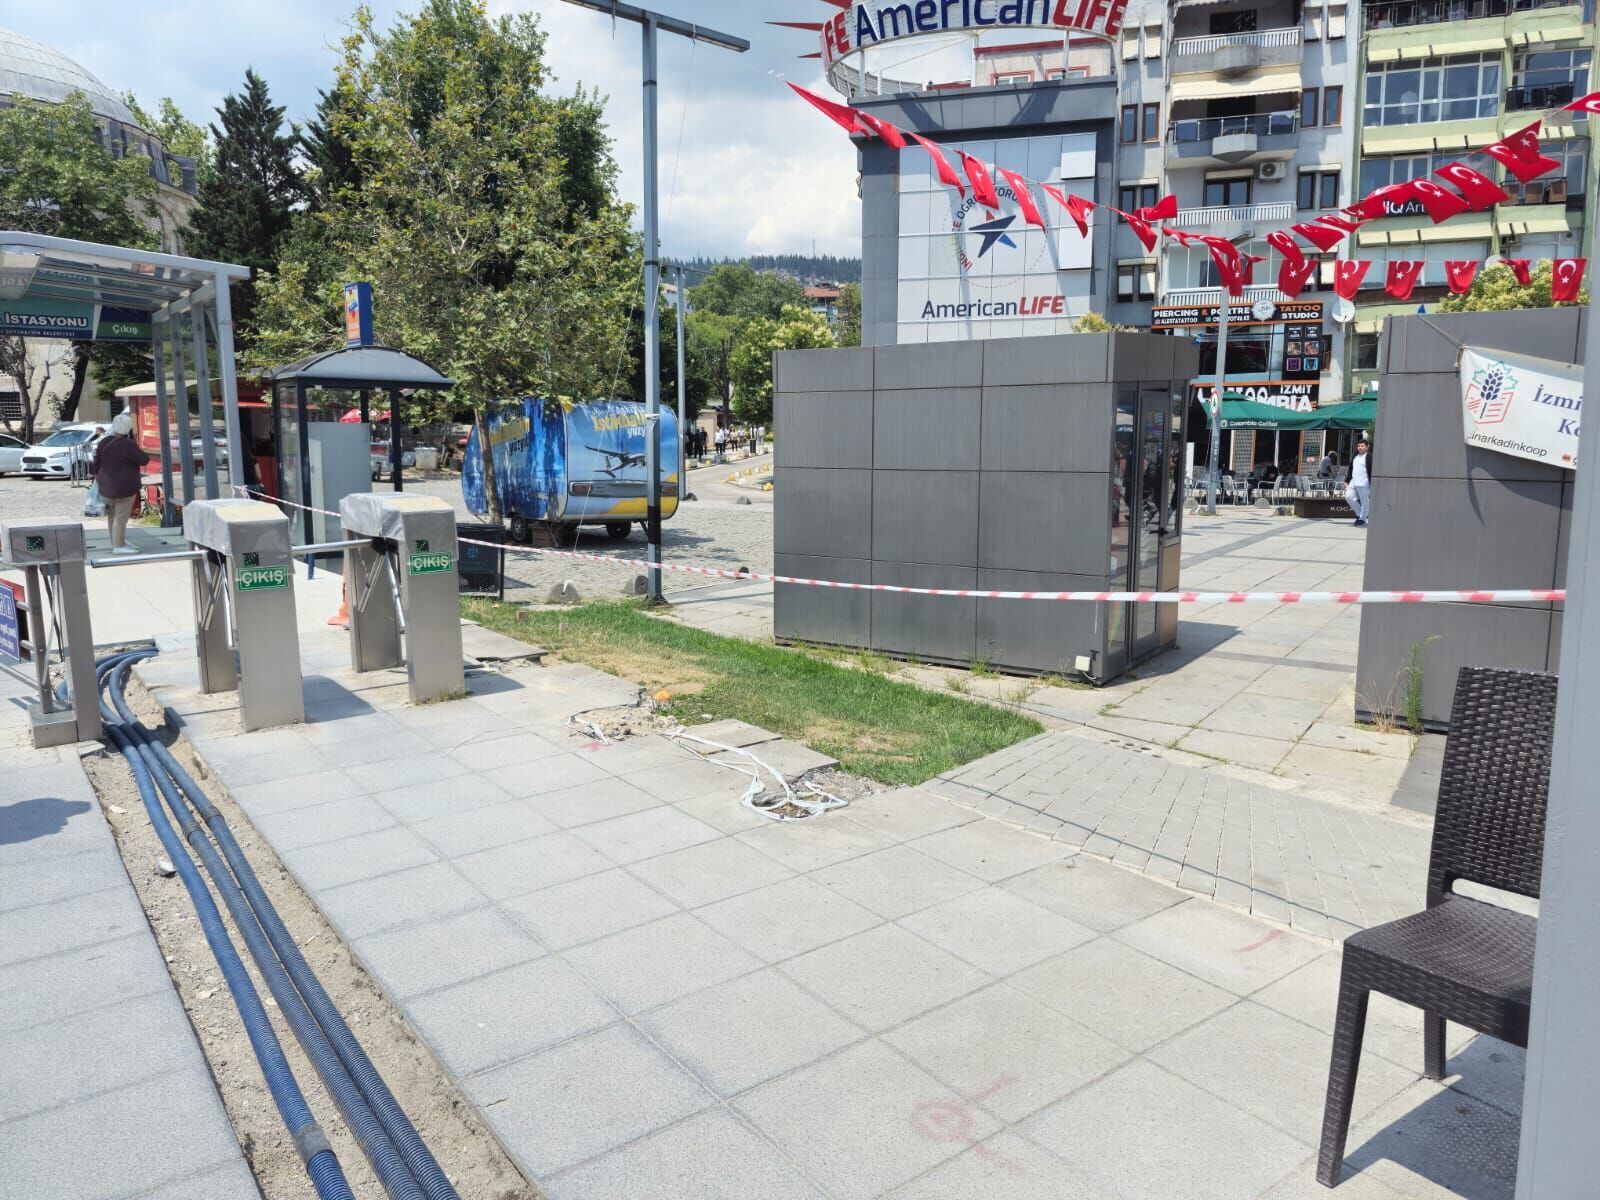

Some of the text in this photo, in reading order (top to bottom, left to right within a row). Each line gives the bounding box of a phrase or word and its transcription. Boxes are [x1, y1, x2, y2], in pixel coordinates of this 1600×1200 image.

[1153, 309, 1199, 318] PIERCING
[1280, 304, 1321, 312] TATTOO
[5, 312, 88, 327] İSTASYONU
[1281, 312, 1320, 320] STUDIO
[112, 324, 139, 335] Çıkış
[1532, 384, 1583, 411] İzmi
[413, 553, 450, 570] ÇIKIŞ
[240, 568, 285, 588] ÇIKIŞ
